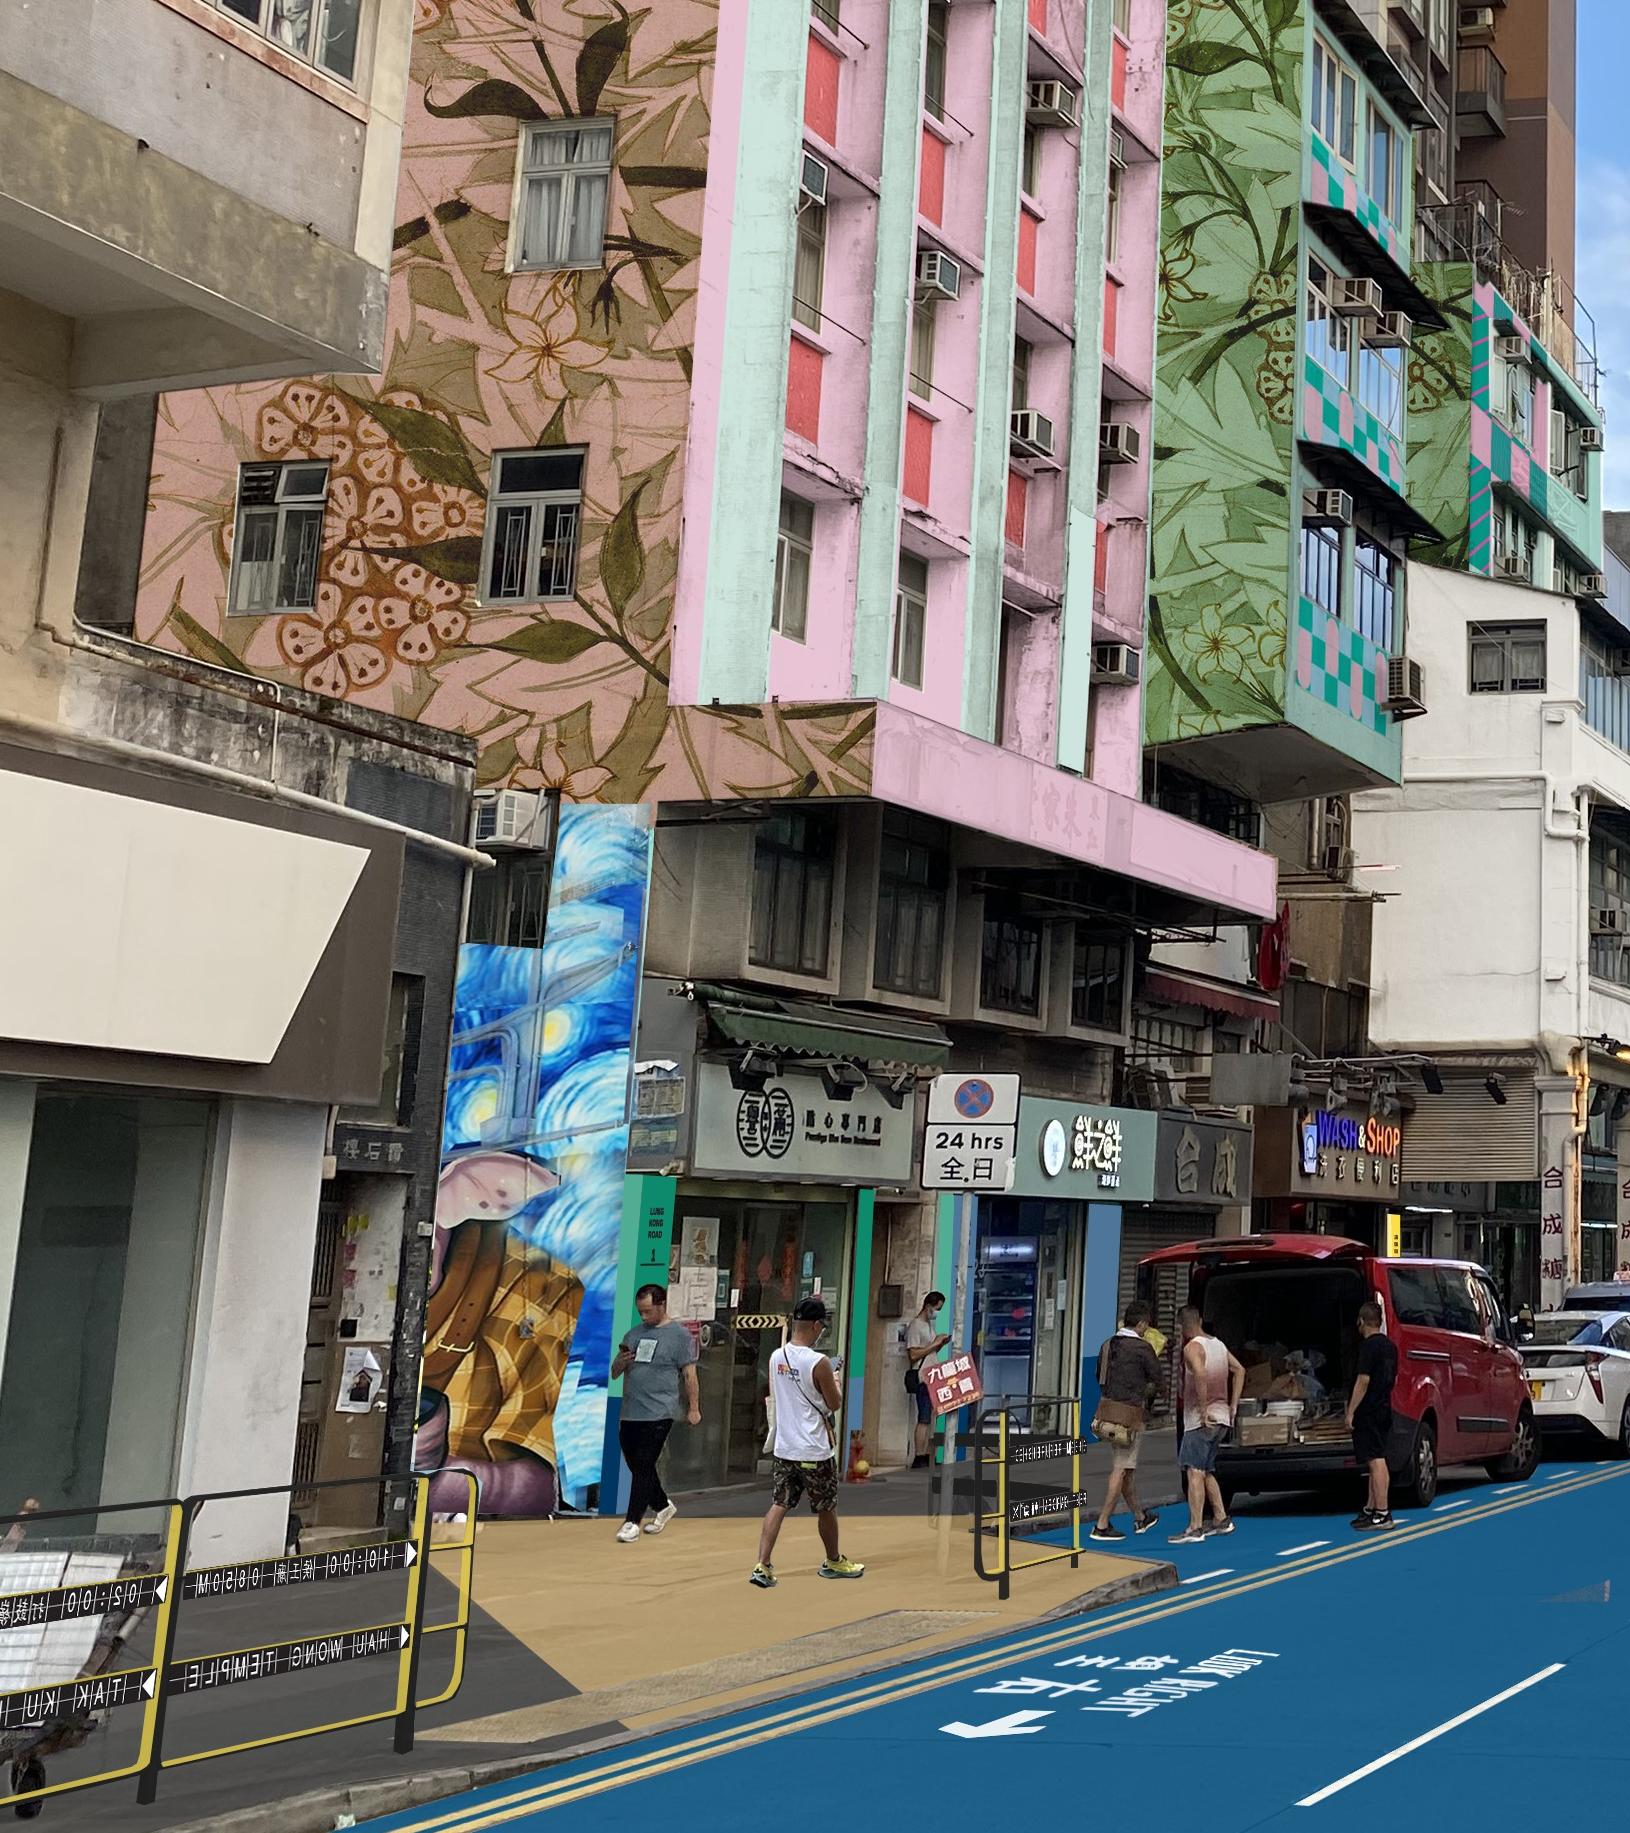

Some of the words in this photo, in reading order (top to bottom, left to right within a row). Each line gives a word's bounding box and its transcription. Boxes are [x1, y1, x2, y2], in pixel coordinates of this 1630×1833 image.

[935, 1131, 964, 1150] 24
[970, 1131, 1004, 1150] hrs
[940, 1157, 993, 1182] 全日
[648, 1231, 662, 1239] ROAD
[1178, 1648, 1281, 1679] LOOK
[1080, 1677, 1218, 1717] RIGHT
